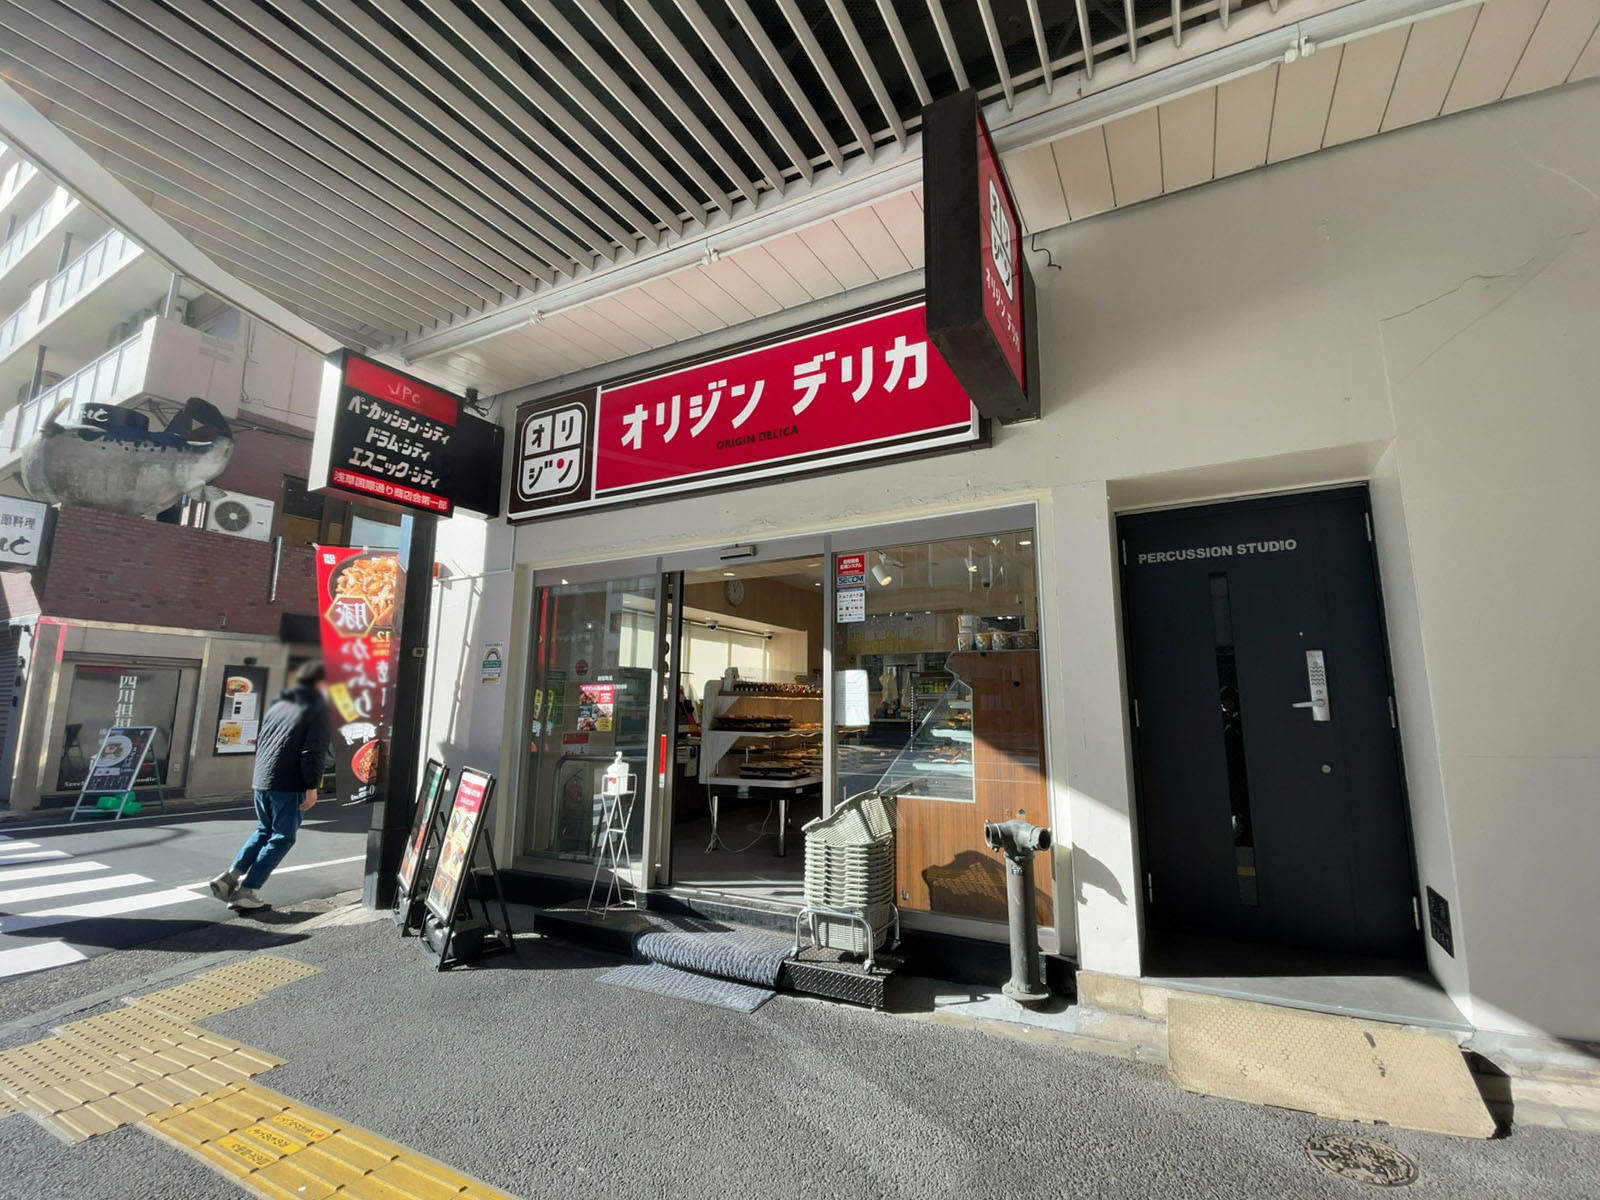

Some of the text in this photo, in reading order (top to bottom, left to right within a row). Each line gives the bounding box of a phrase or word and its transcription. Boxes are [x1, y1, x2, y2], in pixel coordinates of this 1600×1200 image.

[620, 335, 928, 450] オリジン デリカ
[716, 424, 799, 450] ORIGIN DELICA
[1138, 539, 1298, 565] PERCUSSION STUDIO
[838, 574, 864, 585] SECOM
